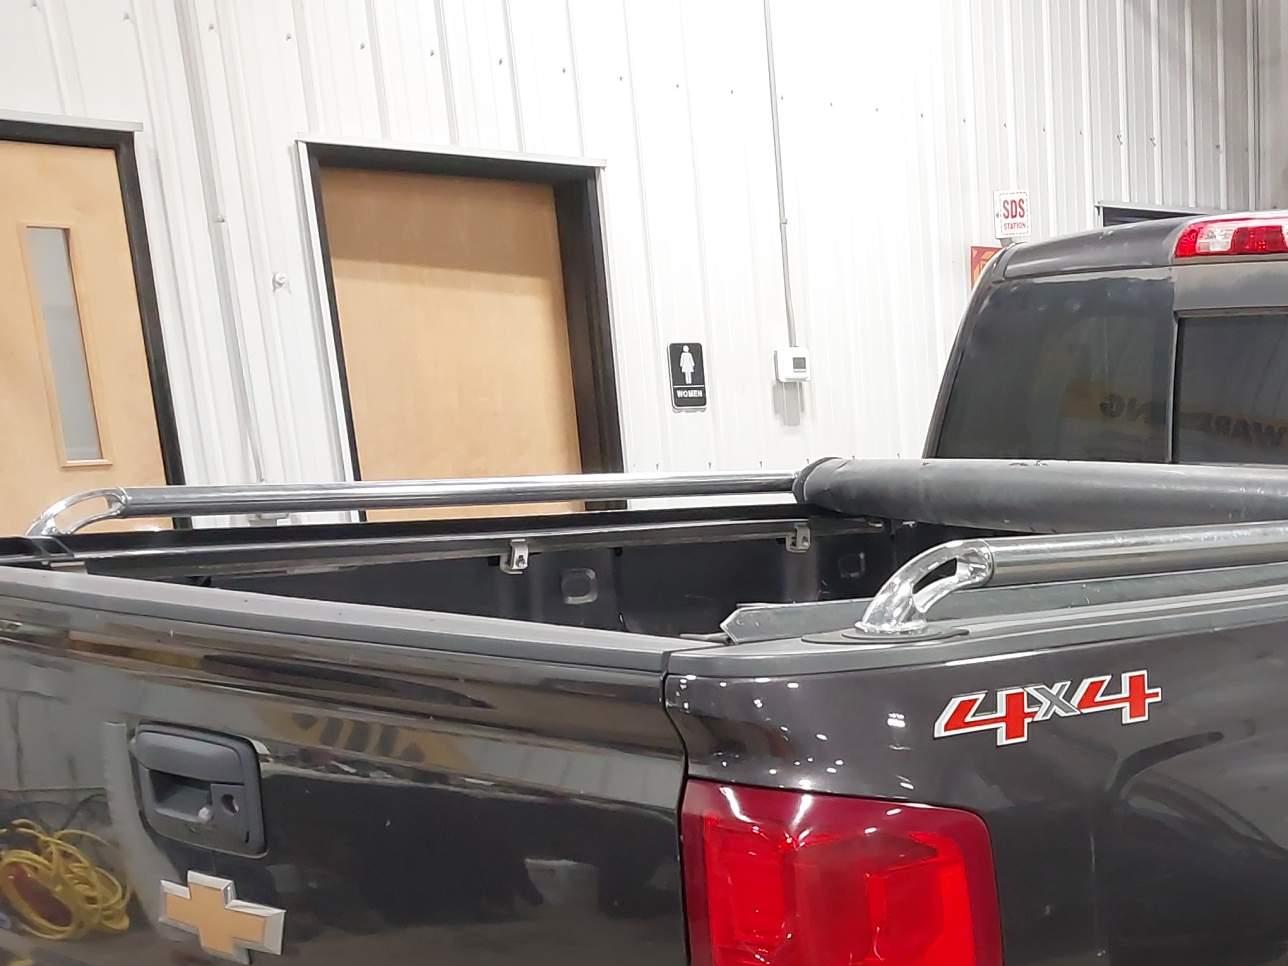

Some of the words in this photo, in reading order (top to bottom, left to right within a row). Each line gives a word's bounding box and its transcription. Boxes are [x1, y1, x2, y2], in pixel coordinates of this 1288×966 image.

[1002, 198, 1025, 219] SDS
[1003, 222, 1026, 230] STATION
[676, 389, 703, 398] WOMEN
